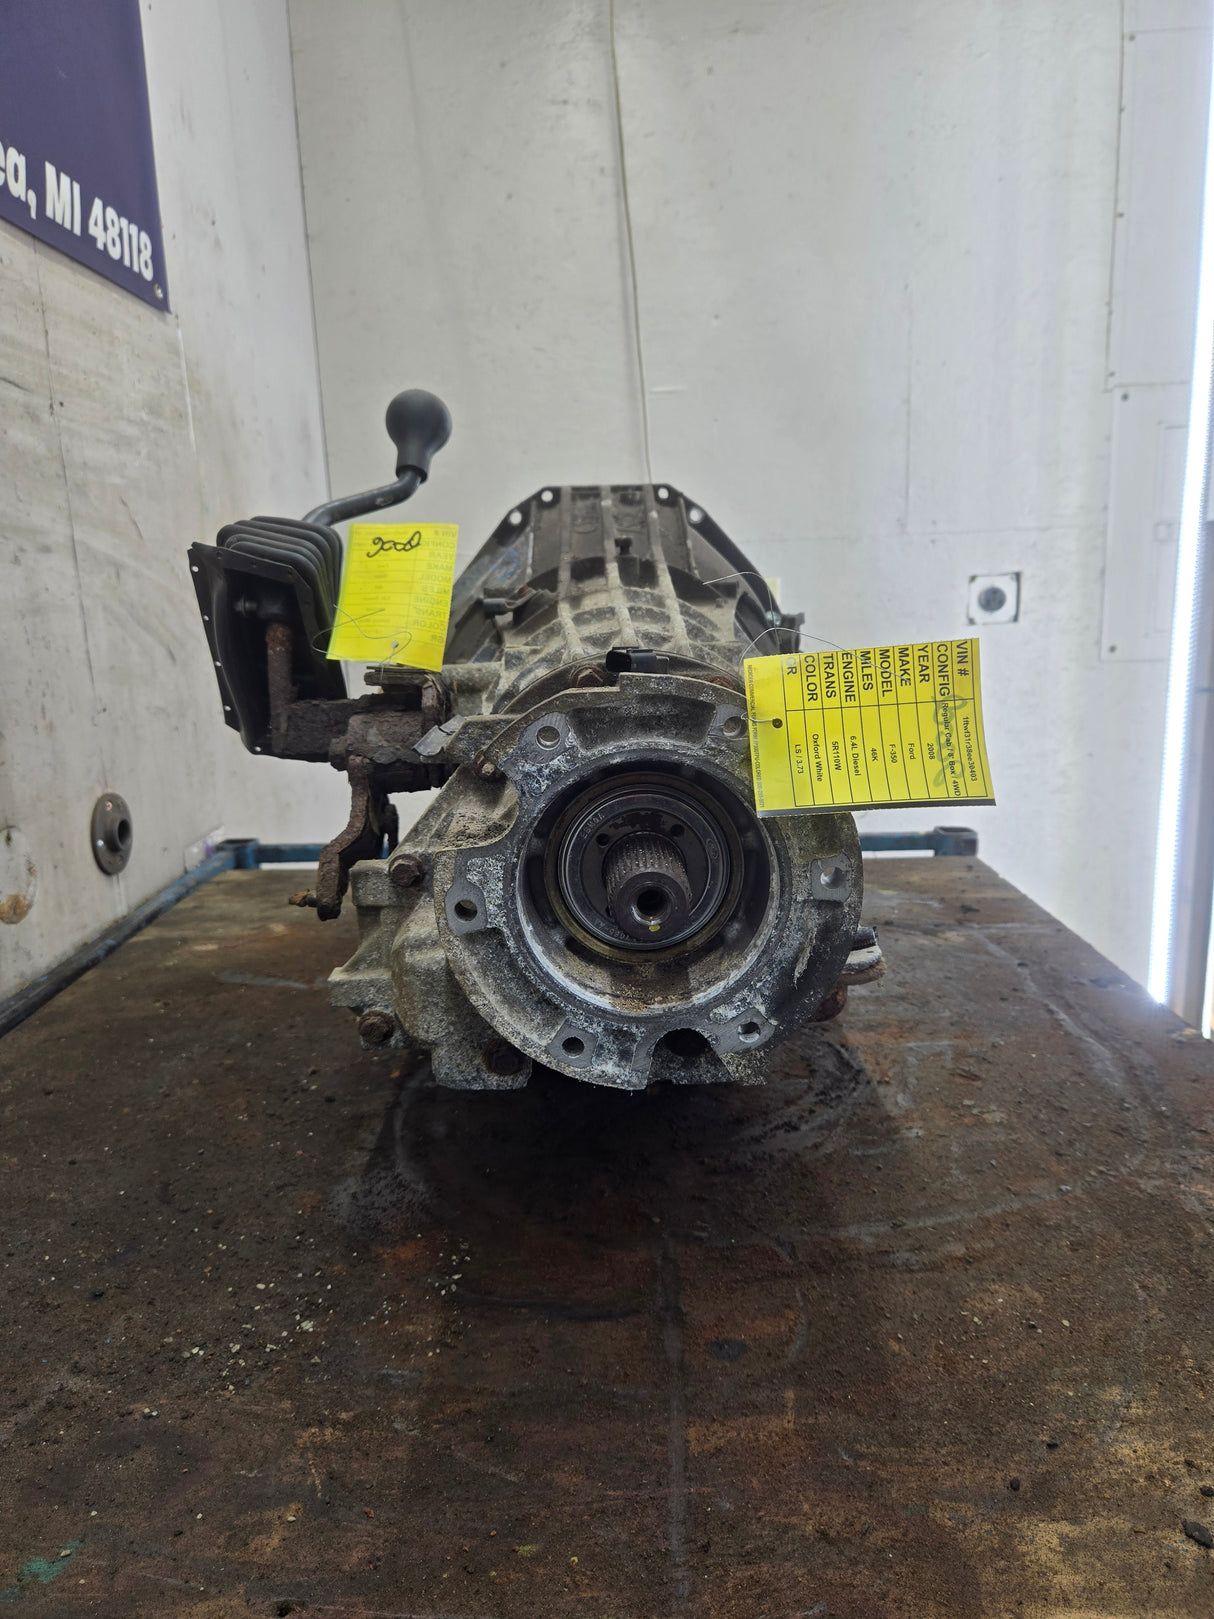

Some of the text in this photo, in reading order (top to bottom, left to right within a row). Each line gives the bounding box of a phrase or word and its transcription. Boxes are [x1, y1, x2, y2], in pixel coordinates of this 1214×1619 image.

[0, 141, 154, 281] a, MI 48118
[785, 656, 797, 675] GR
[804, 655, 818, 702] COLOR
[823, 653, 837, 699] TRANS
[841, 652, 856, 702] ENGINE
[860, 650, 874, 691] MILES
[879, 649, 892, 697] MODEL
[898, 647, 911, 687] MAKE
[918, 645, 930, 683] YEAR
[937, 644, 950, 697] CONFIG
[956, 641, 969, 676] VIN #
[795, 744, 802, 754] LS
[796, 760, 804, 774] 3.73
[812, 733, 823, 782] Oxford White
[832, 741, 842, 771] 5R110W
[850, 735, 861, 776] 6.4L Diesel
[870, 748, 878, 762] 46K
[889, 744, 898, 764] F-350
[908, 743, 916, 760] Ford
[927, 743, 935, 760] 2008
[942, 703, 951, 730] Regular
[952, 780, 961, 797] 4WD
